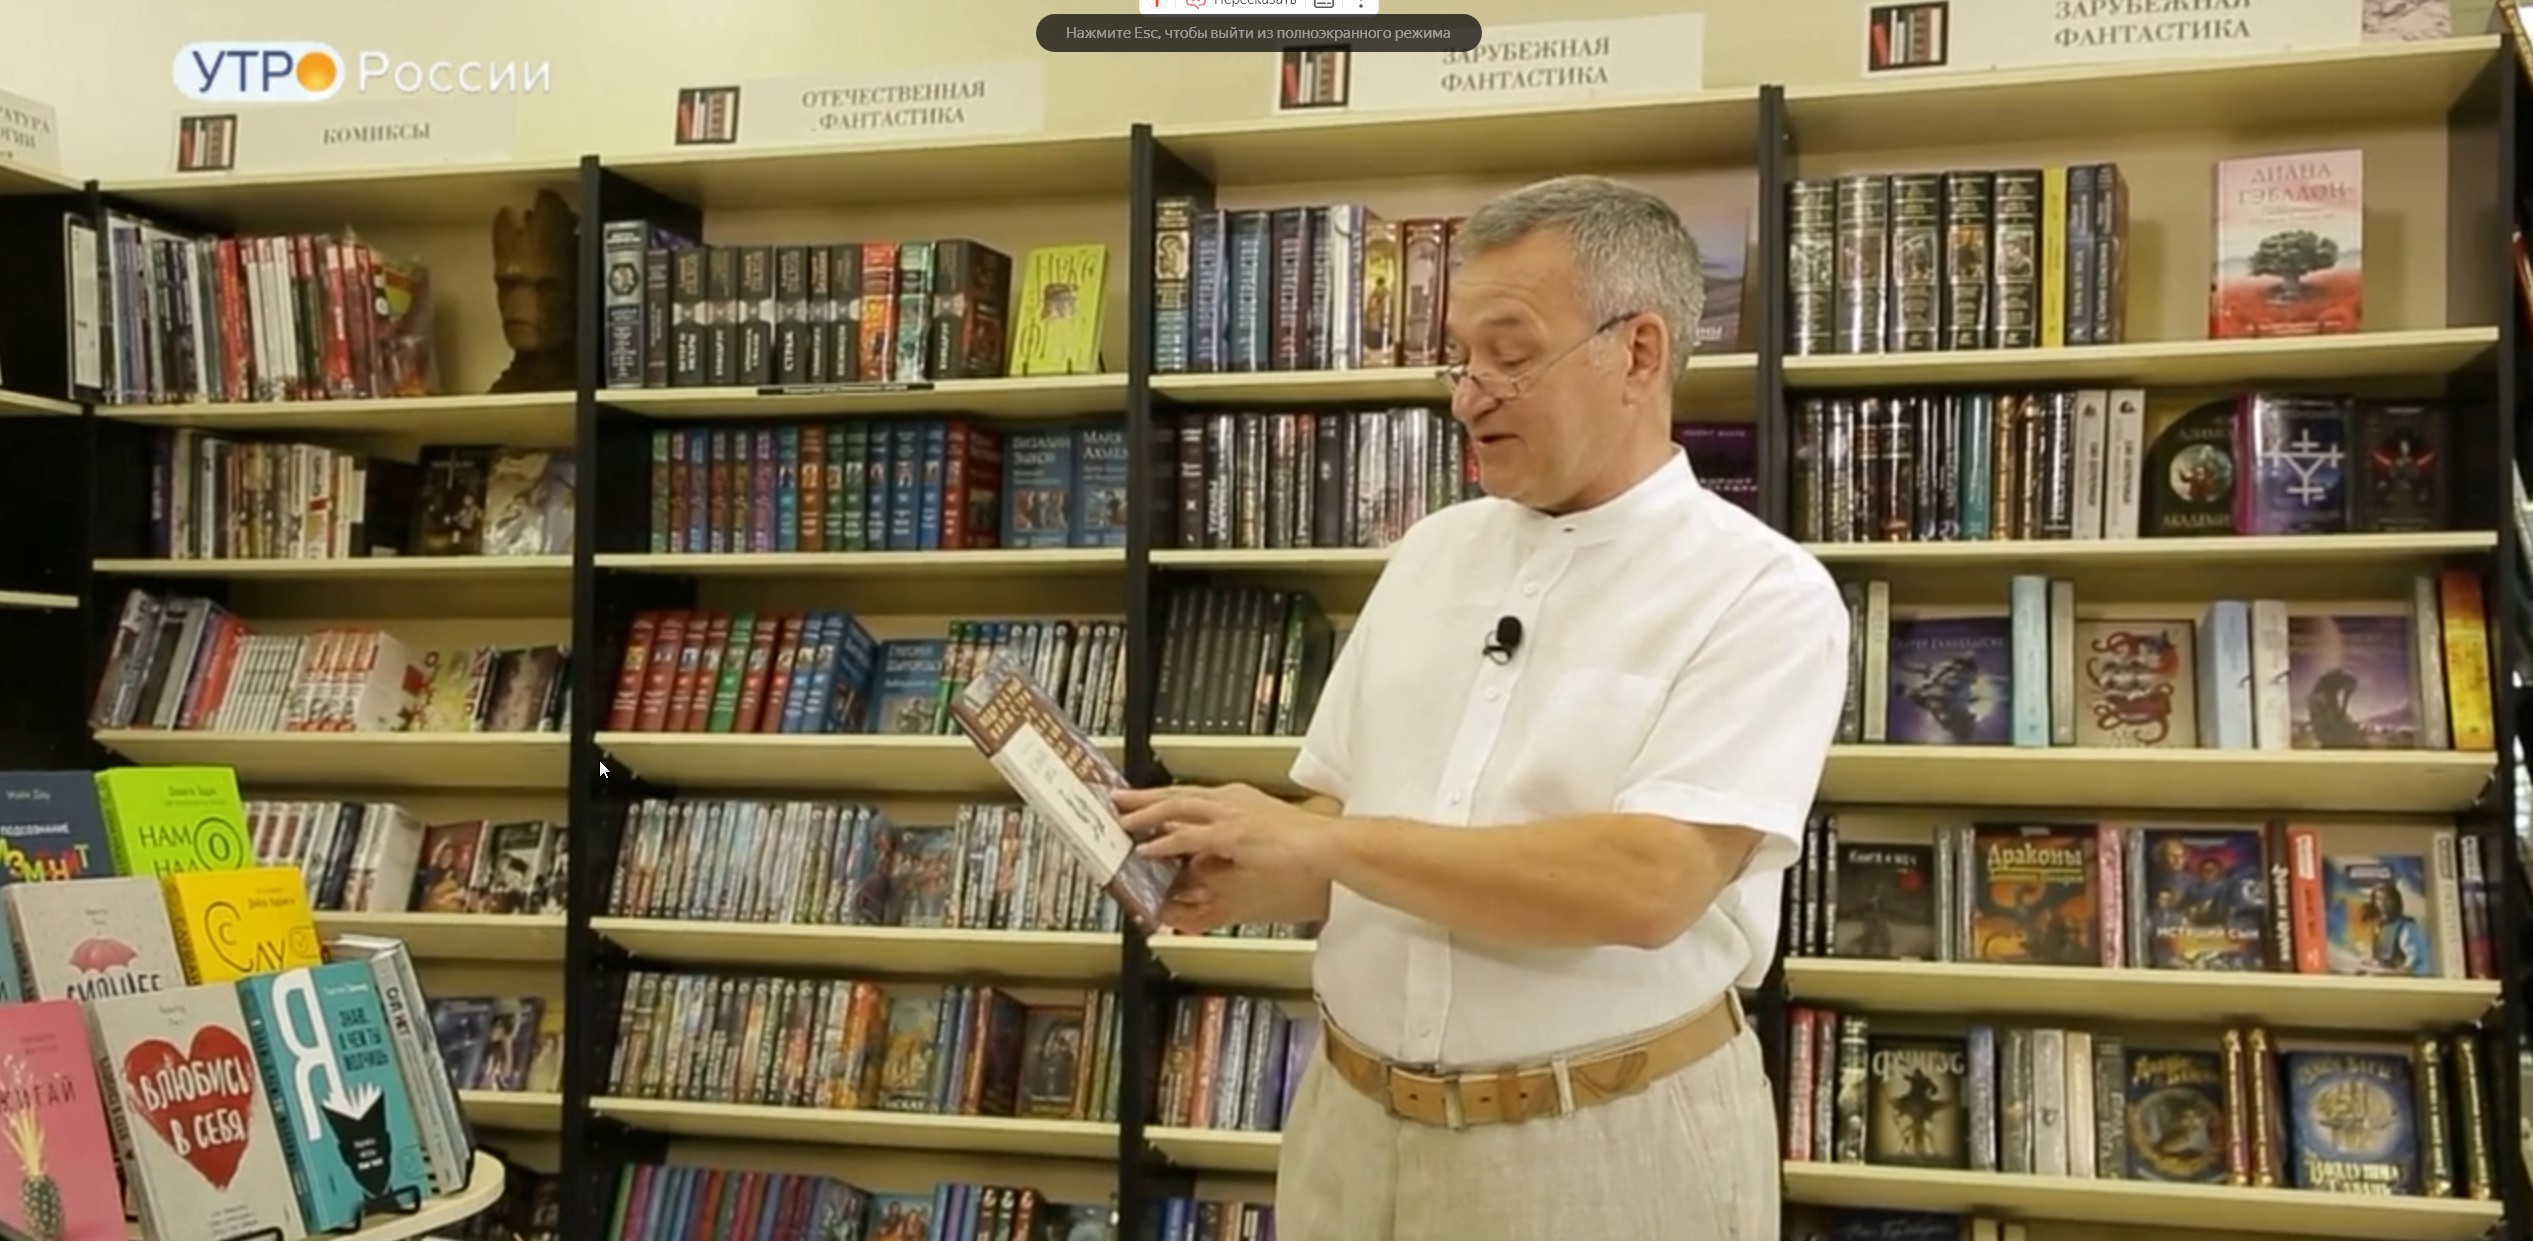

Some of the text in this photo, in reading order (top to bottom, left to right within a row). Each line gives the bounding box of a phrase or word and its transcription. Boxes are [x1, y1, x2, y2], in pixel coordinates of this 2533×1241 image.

[2054, 19, 2250, 47] ФАНТАСТИКА
[1443, 37, 1609, 65] ЗАРУБЕЖНАЯ
[1441, 66, 1608, 92] ФАНТАСТИКА
[802, 81, 986, 108] ОТЕЧЕСТВЕННАЯ
[819, 106, 965, 131] ФАНТАСТИКА
[323, 123, 430, 145] КОМИКСЫ
[1987, 842, 2083, 871] Драконы
[140, 1056, 250, 1111] ВЛЮБИСЬ
[169, 1108, 247, 1155] В СЕБЯ
